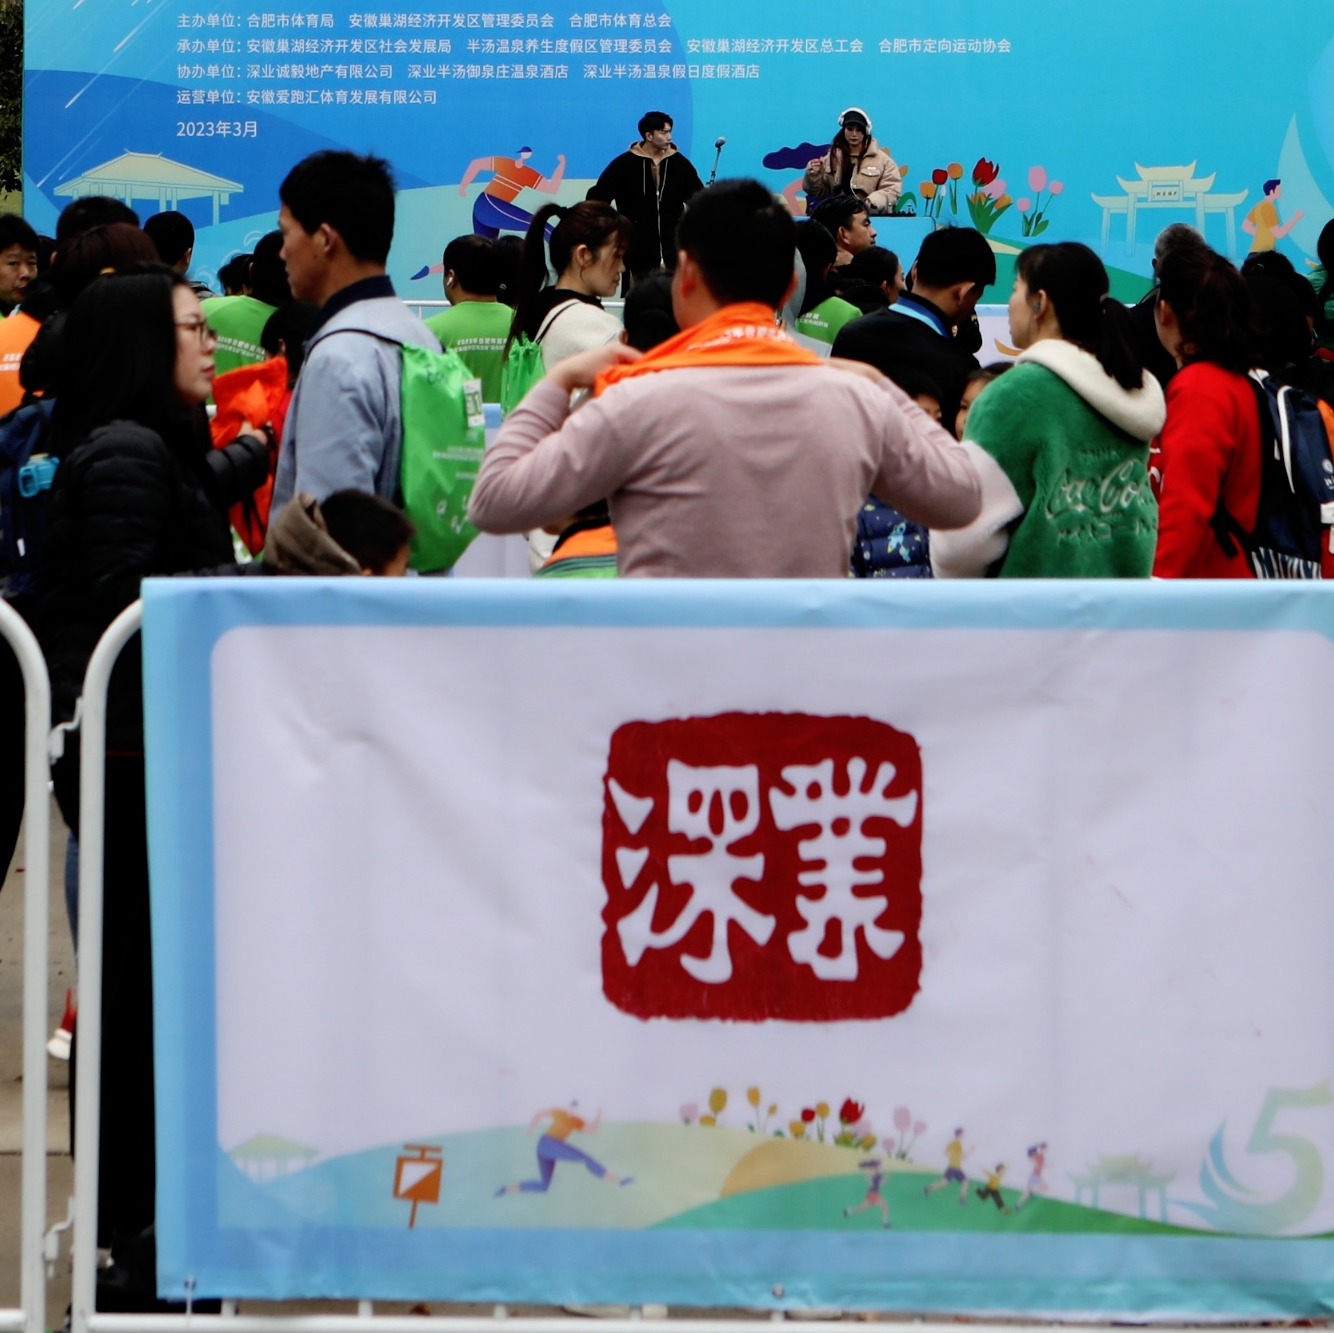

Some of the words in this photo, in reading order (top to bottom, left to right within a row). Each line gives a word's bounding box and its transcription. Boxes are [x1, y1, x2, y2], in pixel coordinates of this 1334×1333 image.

[349, 12, 555, 29] 安徽巢湖经济开发区管理委员会
[569, 12, 672, 29] 合肥市体育总会
[467, 38, 673, 54] 半汤温泉养生度假区管理委员会
[687, 38, 864, 54] 安徽巢湖经济开发区总工会
[878, 38, 1012, 54] 合肥市定向运动协会
[408, 63, 569, 79] 深业半汤御泉庄温泉酒店
[584, 63, 760, 79] 深业半汤温泉假日度假酒店
[177, 120, 258, 138] 2023年3月
